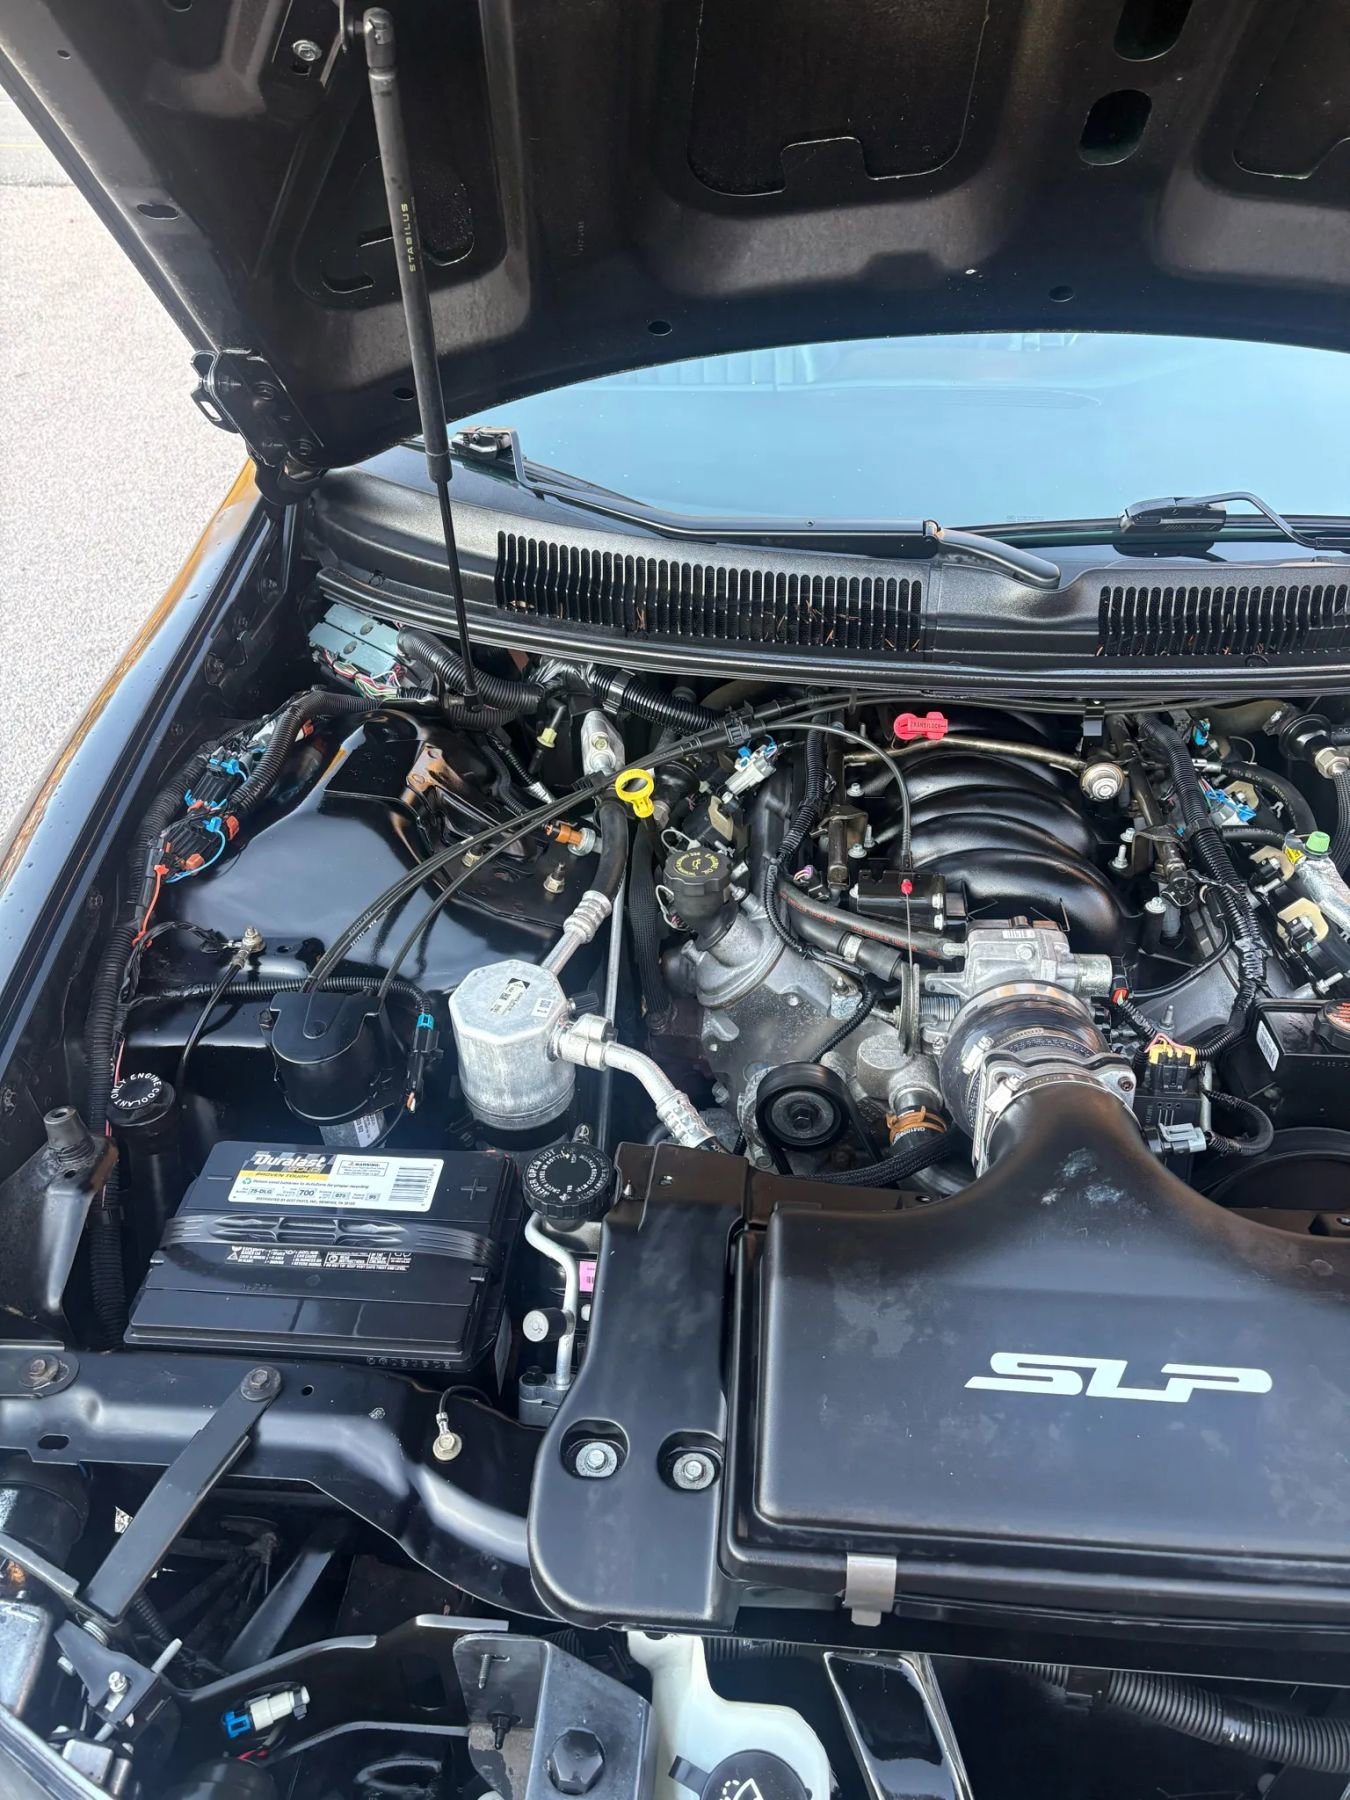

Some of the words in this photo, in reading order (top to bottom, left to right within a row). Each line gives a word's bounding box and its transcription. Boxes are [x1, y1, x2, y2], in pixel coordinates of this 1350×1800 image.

[400, 203, 416, 272] STABILUS
[110, 1078, 127, 1099] ONLY
[130, 1072, 162, 1087] ENGINE
[113, 1087, 160, 1107] COOLANT
[253, 1154, 327, 1167] Duralast
[528, 1159, 542, 1178] OPEN
[963, 1351, 1273, 1403] SLP
